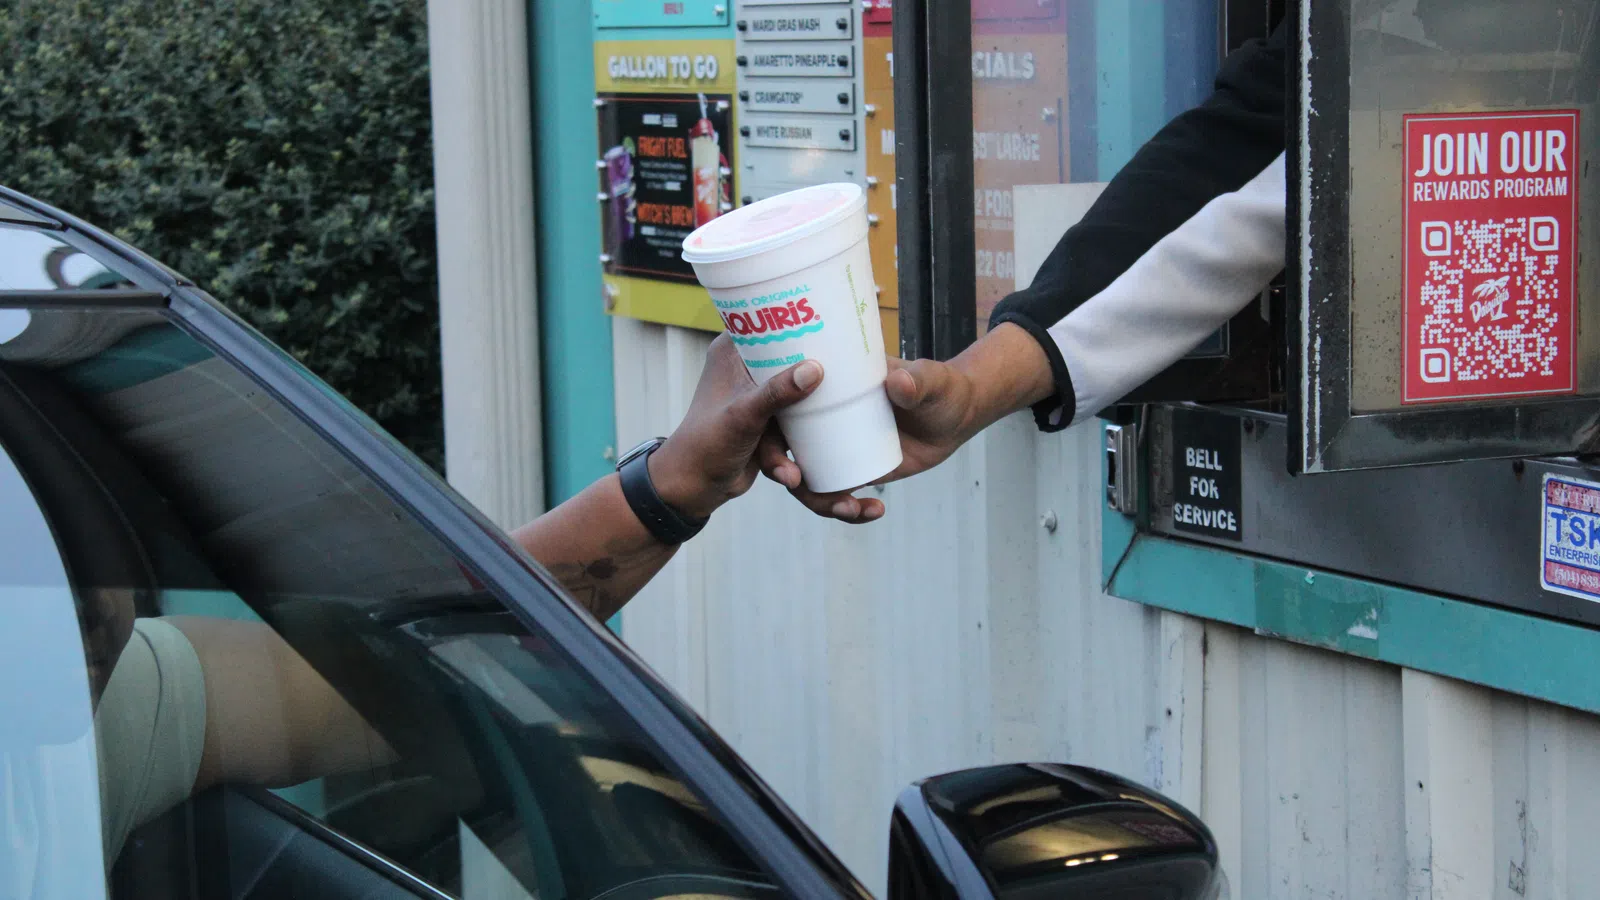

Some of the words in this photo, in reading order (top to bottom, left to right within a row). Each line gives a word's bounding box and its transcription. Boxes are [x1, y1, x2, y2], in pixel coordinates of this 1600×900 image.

[752, 19, 776, 32] MARDI
[777, 19, 797, 32] GRAS
[607, 55, 667, 79] GALLON
[669, 56, 691, 79] TO
[693, 56, 718, 79] GO
[753, 55, 794, 67] AMARETTO
[795, 55, 836, 67] PINEAPPLE
[971, 51, 1035, 79] CIALS
[755, 126, 779, 138] WHITE
[780, 126, 812, 140] RUSSIAN
[638, 135, 666, 156] FRIGHT
[667, 137, 687, 158] FUEL
[1413, 131, 1489, 177] JOIN
[1500, 129, 1567, 174] OUR
[1413, 178, 1490, 202] REWARDS
[1494, 176, 1568, 199] PROGRAM
[637, 203, 671, 225] WITCH'S
[713, 298, 748, 309] RLEANS
[751, 284, 812, 306] ORIGINAL
[1185, 446, 1223, 471] BELL
[1189, 476, 1220, 499] FOR
[1174, 502, 1237, 532] SERVICE
[1549, 544, 1600, 567] ENTERPRIS
